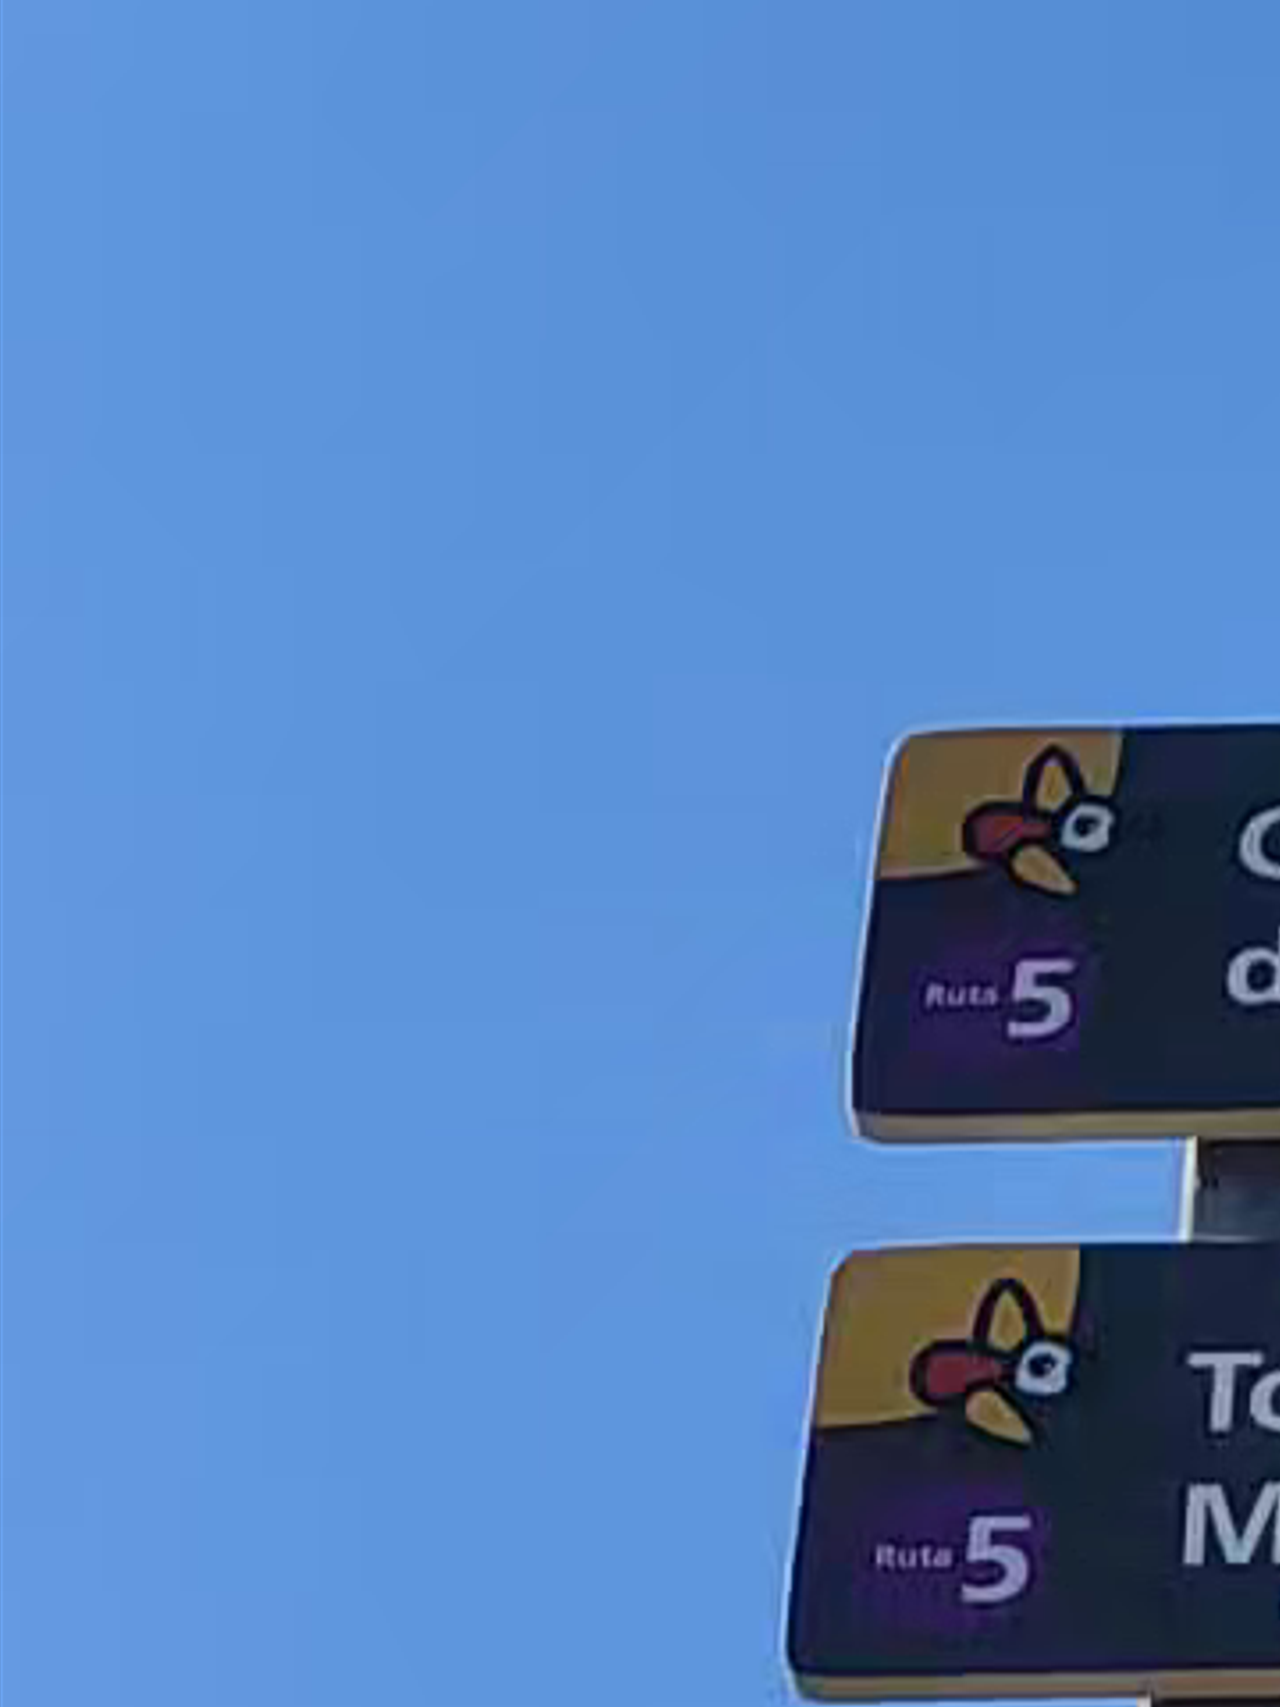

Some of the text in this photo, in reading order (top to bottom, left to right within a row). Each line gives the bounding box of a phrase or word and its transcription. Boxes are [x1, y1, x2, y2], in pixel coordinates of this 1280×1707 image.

[925, 957, 1075, 1038] Ruta 5
[874, 1515, 1032, 1603] Ruta 5
